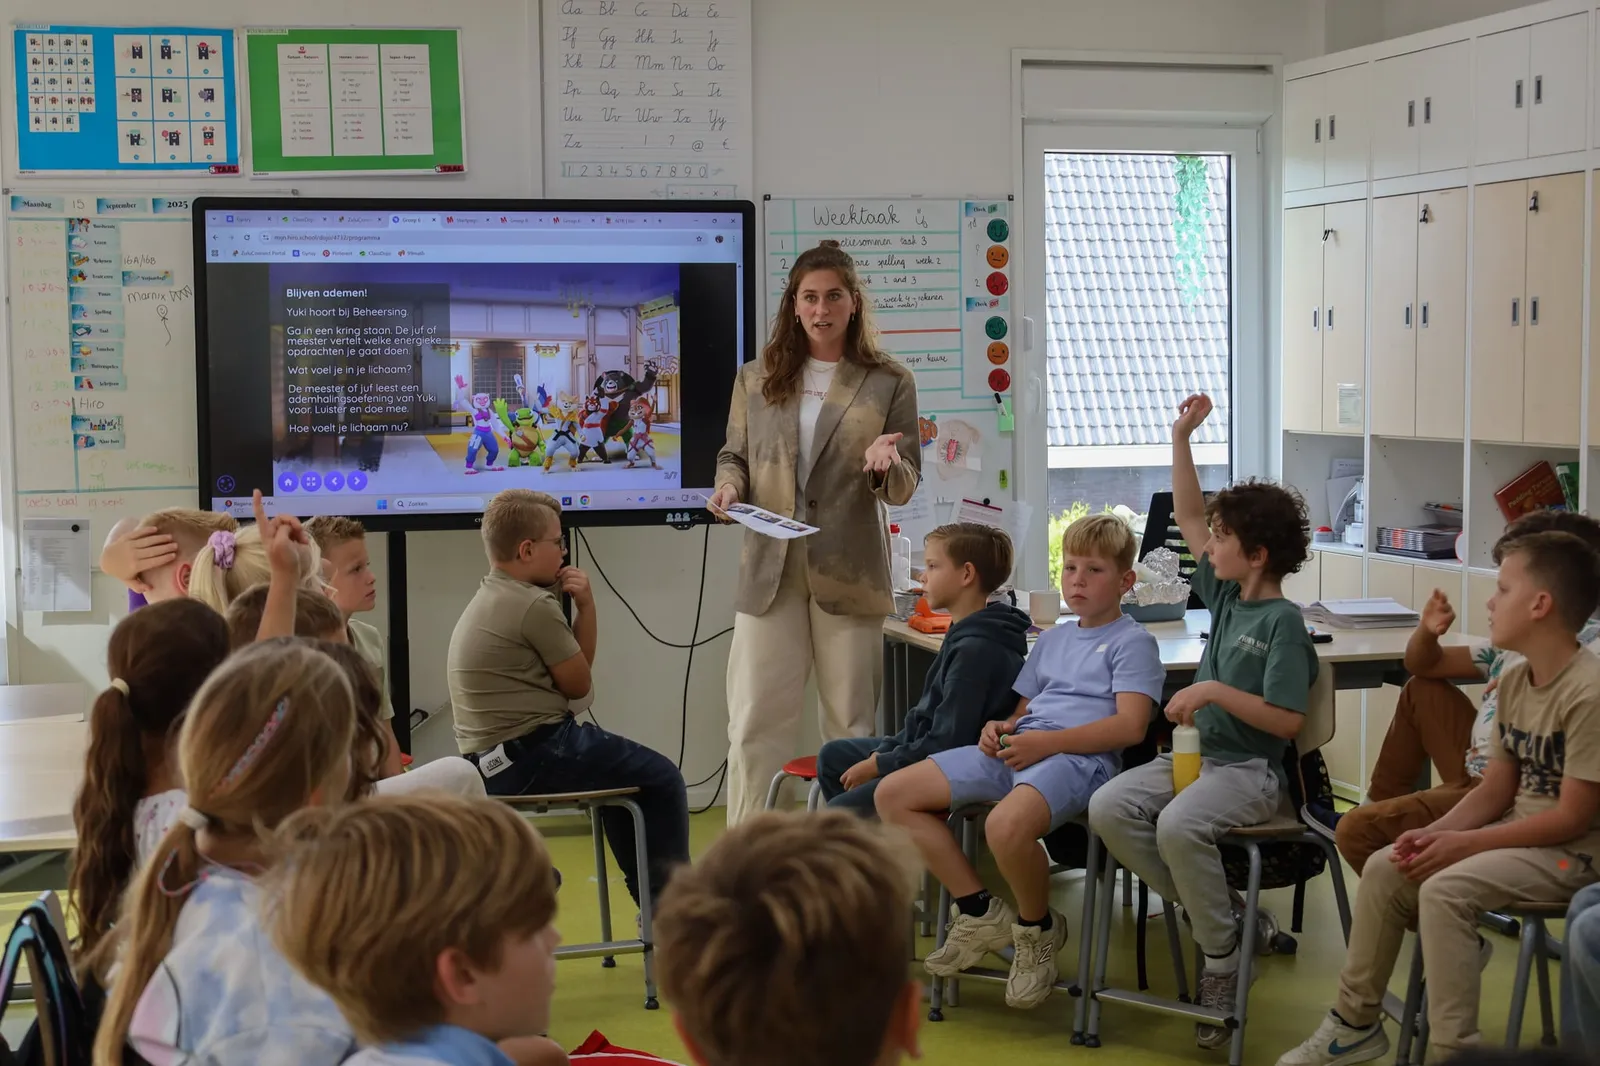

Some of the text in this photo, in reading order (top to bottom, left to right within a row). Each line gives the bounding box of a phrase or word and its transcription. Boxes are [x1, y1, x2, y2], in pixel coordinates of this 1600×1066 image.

[562, 0, 719, 18] Aa Bb Cc Dd Ee
[599, 28, 617, 49] Gg
[634, 28, 655, 43] Hh
[562, 54, 725, 71] Kk Ll Mm Nn Oo
[562, 80, 581, 98] Pp
[600, 81, 620, 99] Qq
[634, 82, 655, 96] Rr
[672, 82, 684, 97] Ss
[562, 107, 726, 131] Uu Vv Ww Xx Yy
[564, 134, 582, 148] Zz
[692, 140, 704, 152] @
[580, 166, 588, 177] 2
[597, 166, 603, 177] 3
[610, 166, 618, 177] 4
[626, 166, 632, 177] 5
[640, 166, 647, 177] 6
[655, 166, 662, 177] 7
[670, 166, 676, 177] 8
[684, 166, 691, 177] 9
[699, 166, 706, 177] 0
[72, 199, 85, 208] 15
[813, 205, 900, 227] Weektaak
[841, 238, 892, 247] ctiesommen
[921, 236, 928, 246] 3
[123, 254, 156, 267] 16A/16B
[780, 260, 789, 269] 2
[877, 255, 906, 269] spelling
[916, 257, 934, 265] week
[911, 276, 916, 284] 3
[127, 292, 166, 303] Marnix
[286, 288, 367, 299] Blijven ademen!
[287, 307, 408, 318] Yuki hoort bij Beheersing.
[287, 327, 301, 335] Ga
[304, 327, 312, 335] in
[336, 326, 360, 336] kring
[364, 326, 393, 334] staan.
[396, 326, 409, 334] De
[411, 326, 424, 336] juf
[426, 326, 436, 334] of
[330, 337, 361, 345] vertelt
[364, 337, 391, 345] welke
[394, 336, 441, 345] energieke
[288, 348, 344, 357] opdrachten
[346, 348, 356, 357] je
[358, 348, 381, 357] gaat
[288, 365, 411, 376] Wat voel je in je lichaam?
[288, 385, 302, 393] De
[305, 385, 344, 393] meester
[348, 384, 358, 393] of
[360, 384, 373, 394] juf
[376, 384, 398, 392] leest
[80, 397, 104, 409] Hiro
[289, 394, 394, 404] ademhalingsoefening
[416, 394, 436, 402] Yuki
[365, 405, 383, 413] doe
[289, 423, 408, 434] Hoe voelt je lichaam nu?
[57, 497, 77, 508] taal
[102, 499, 124, 512] sept
